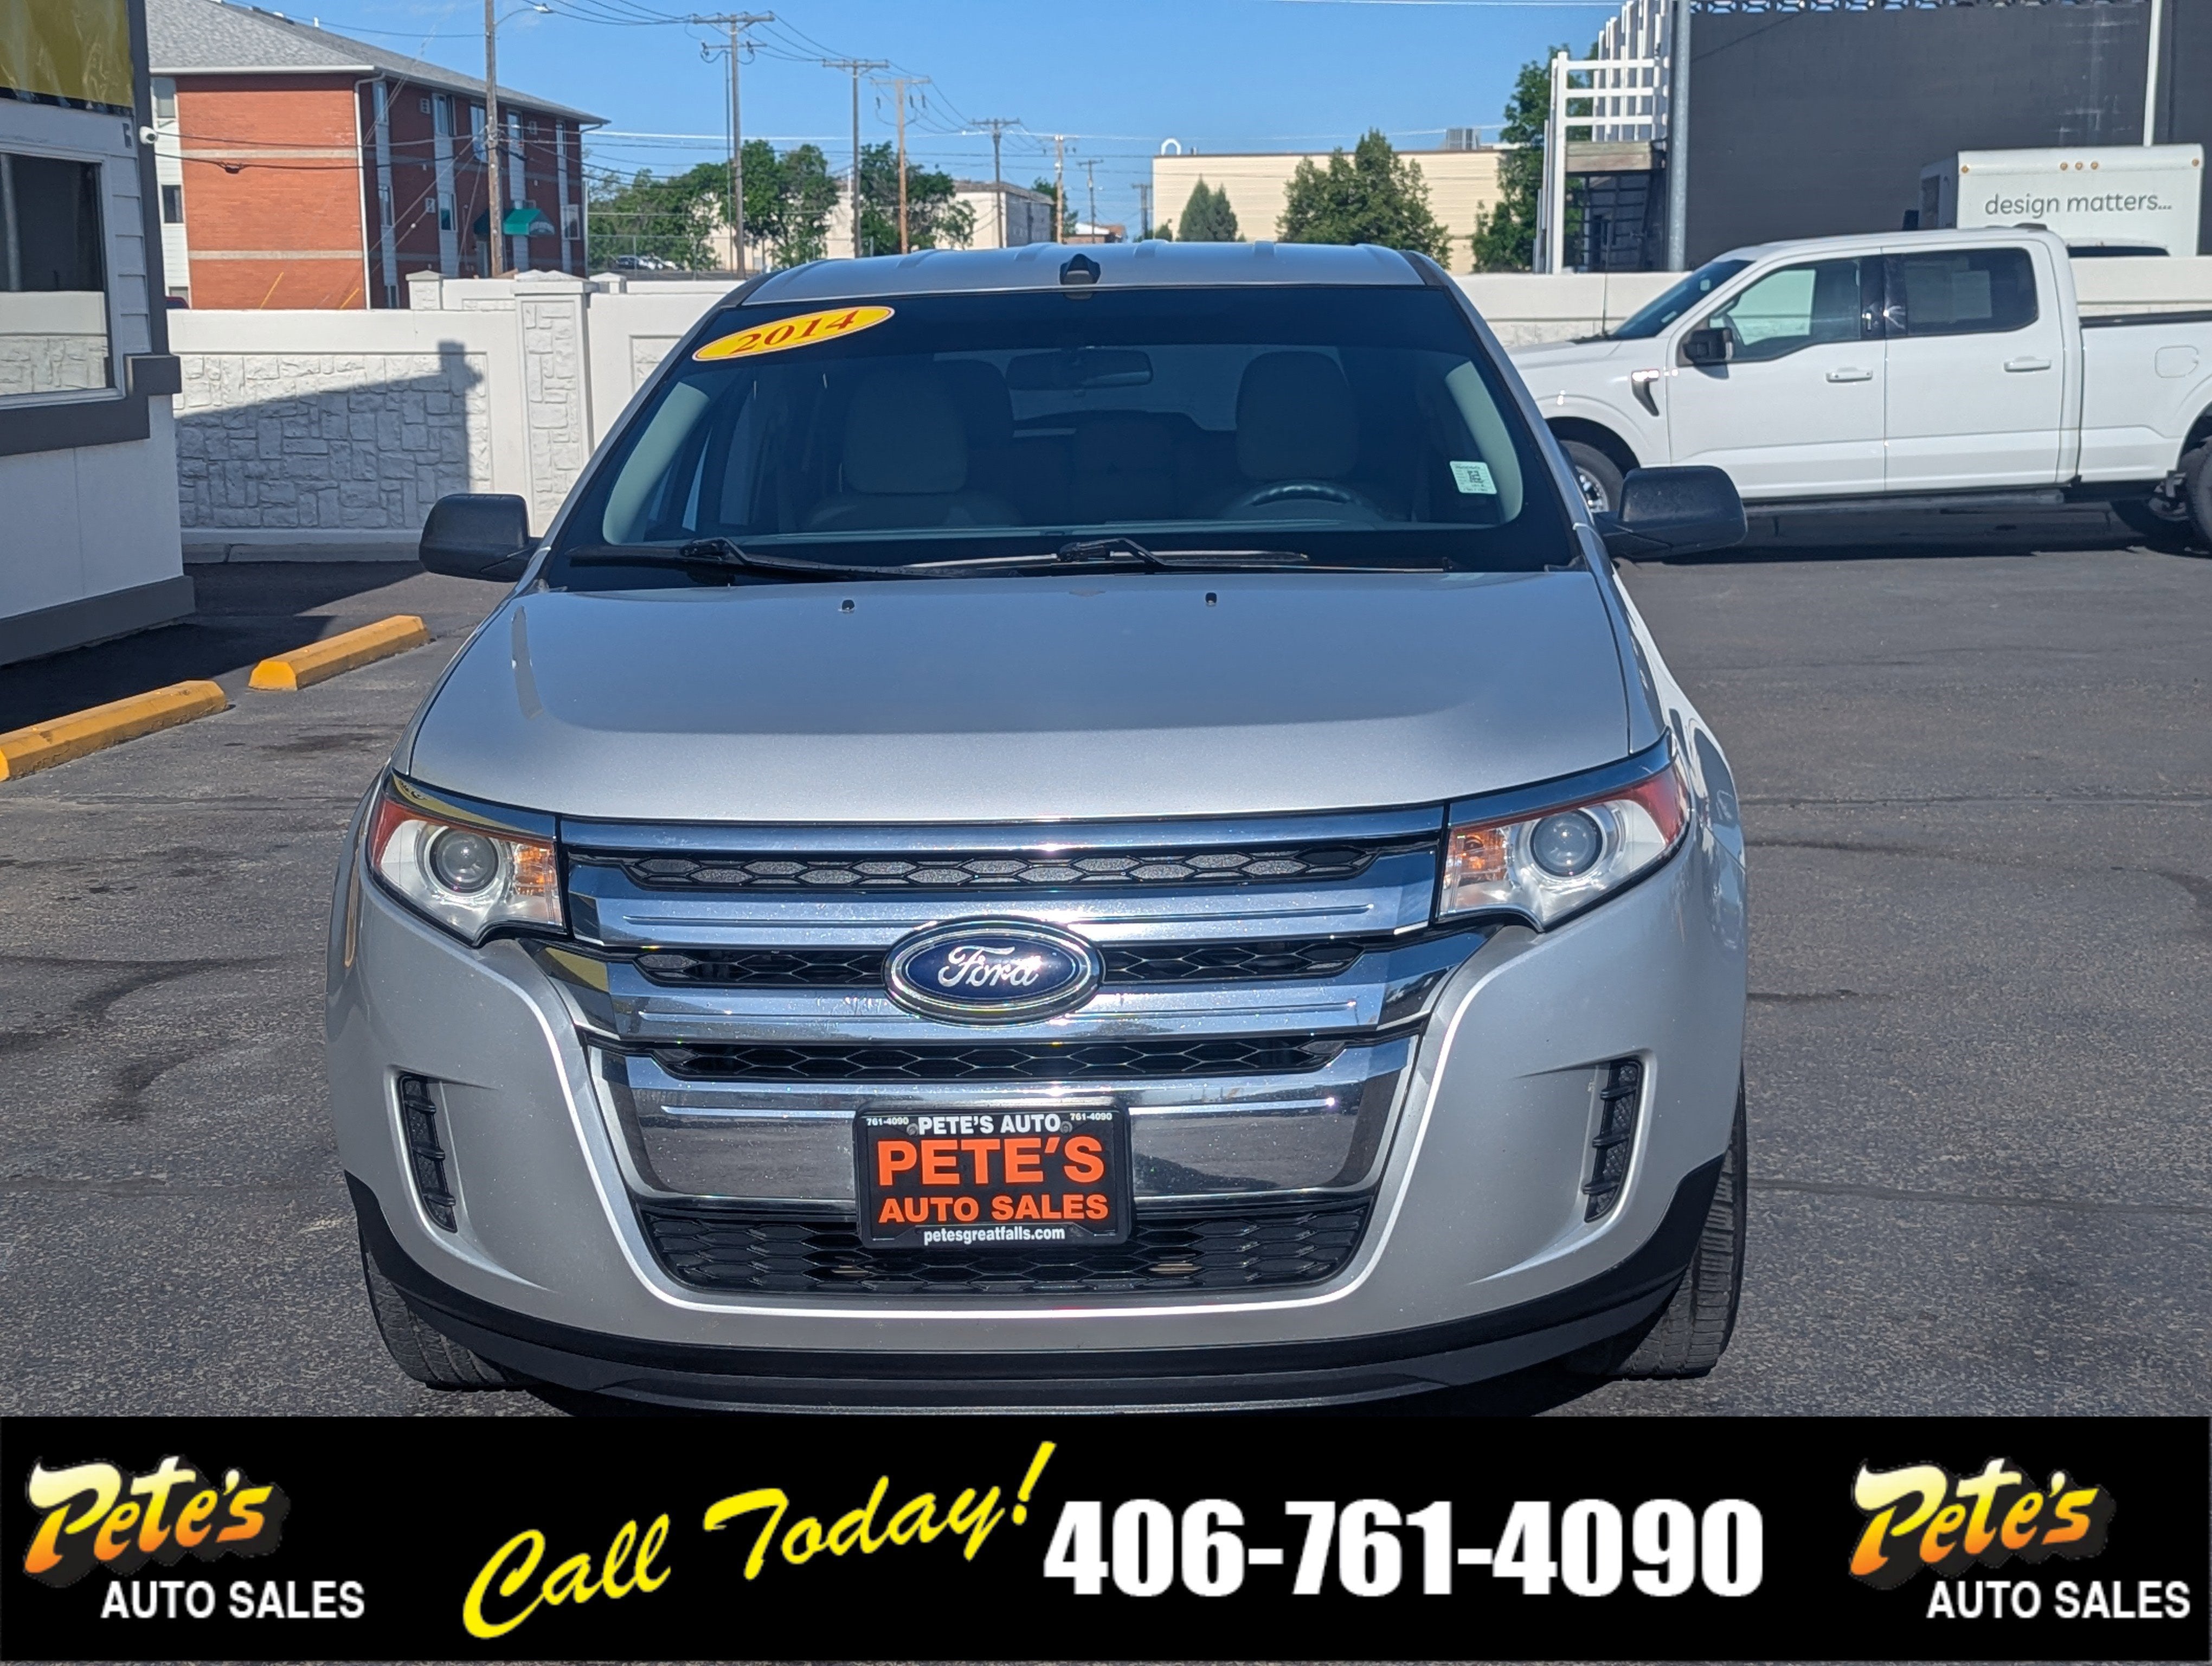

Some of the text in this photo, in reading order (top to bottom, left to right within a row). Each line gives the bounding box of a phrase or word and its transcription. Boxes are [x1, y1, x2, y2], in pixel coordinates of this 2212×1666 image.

[1985, 193, 2172, 219] design matters...
[729, 309, 860, 355] 2014
[937, 945, 1043, 987] Ford
[866, 1117, 909, 1126] 761-4090
[917, 1113, 1060, 1135] PETE'S AUTO
[1069, 1112, 1113, 1121] 761-4090
[877, 1136, 1104, 1186] PETE'S
[878, 1194, 1109, 1223] AUTO SALES
[924, 1226, 1065, 1246] petesgreatfalls.com
